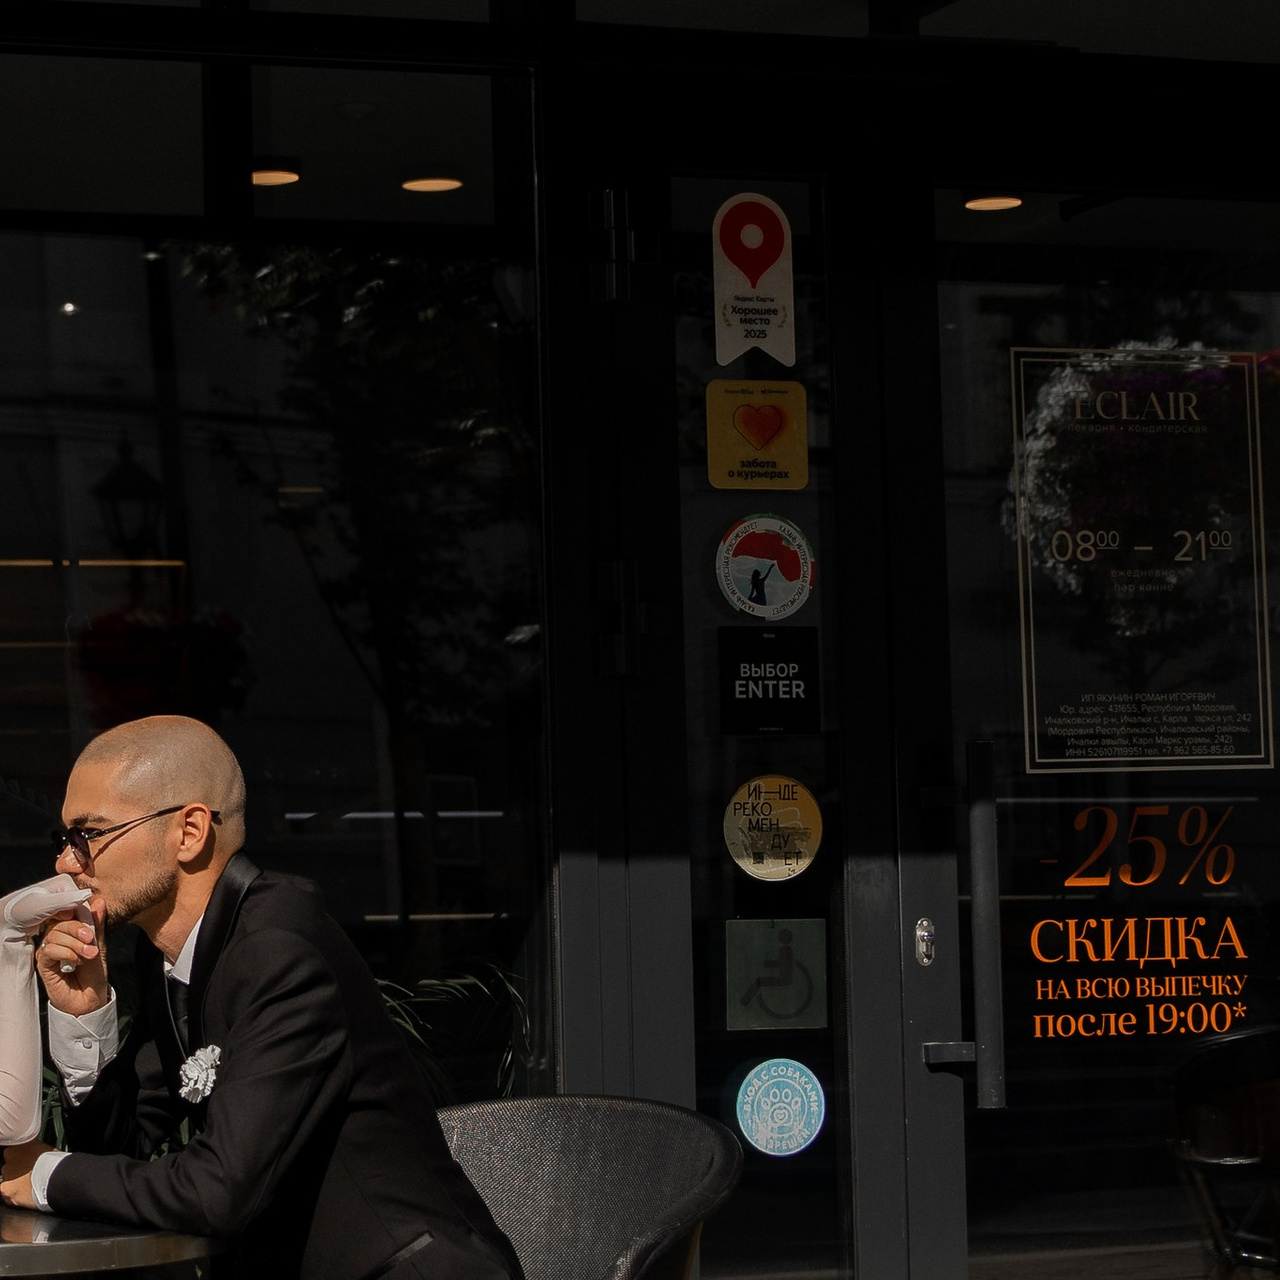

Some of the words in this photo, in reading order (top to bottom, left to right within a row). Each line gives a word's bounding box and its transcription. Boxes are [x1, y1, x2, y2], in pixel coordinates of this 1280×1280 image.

[733, 294, 755, 302] Яндекс
[756, 295, 775, 303] Карты
[730, 305, 779, 317] Хорошее
[739, 317, 771, 326] место
[743, 329, 767, 339] 2025
[1075, 390, 1200, 421] ECLAIR
[1128, 424, 1208, 434] кондитерская
[739, 458, 777, 469] забота
[737, 470, 789, 480] курьерах
[1110, 568, 1176, 579] ежедневно
[740, 663, 799, 677] ВЫБОР
[735, 680, 806, 699] ENTER
[1081, 693, 1095, 703] ИП
[1097, 693, 1133, 702] ЯКУНИН
[1135, 693, 1167, 702] РОМАН
[1120, 715, 1152, 724] Ичалки
[1162, 714, 1188, 724] Карла
[1193, 715, 1221, 725] аркса
[1236, 713, 1252, 722] 242
[1160, 724, 1215, 733] Ичалковский
[1067, 737, 1099, 746] Ичалки
[1132, 736, 1153, 746] Карл
[1155, 735, 1182, 745] Маркс
[1065, 748, 1086, 757] ИНН
[1087, 747, 1142, 757] 526107119951
[1162, 746, 1172, 755] +7
[1173, 746, 1190, 755] 962
[1191, 745, 1235, 755] 565-85-60
[747, 784, 798, 801] ИНДЕ
[733, 802, 772, 817] РЕКО
[748, 818, 780, 833] МЕН
[771, 834, 791, 851] ДУ
[1040, 805, 1236, 887] -25%
[784, 851, 803, 866] ЕТ
[1030, 916, 1249, 970] СКИДКА
[1036, 978, 1072, 1000] НА
[1076, 977, 1130, 999] ВСЮ
[1135, 975, 1249, 998] ВЫПЕЧКУ
[1032, 1011, 1137, 1038] после
[743, 1078, 762, 1111] ВХОД
[760, 1070, 769, 1080] С
[771, 1066, 819, 1112] СОБАКАМИ
